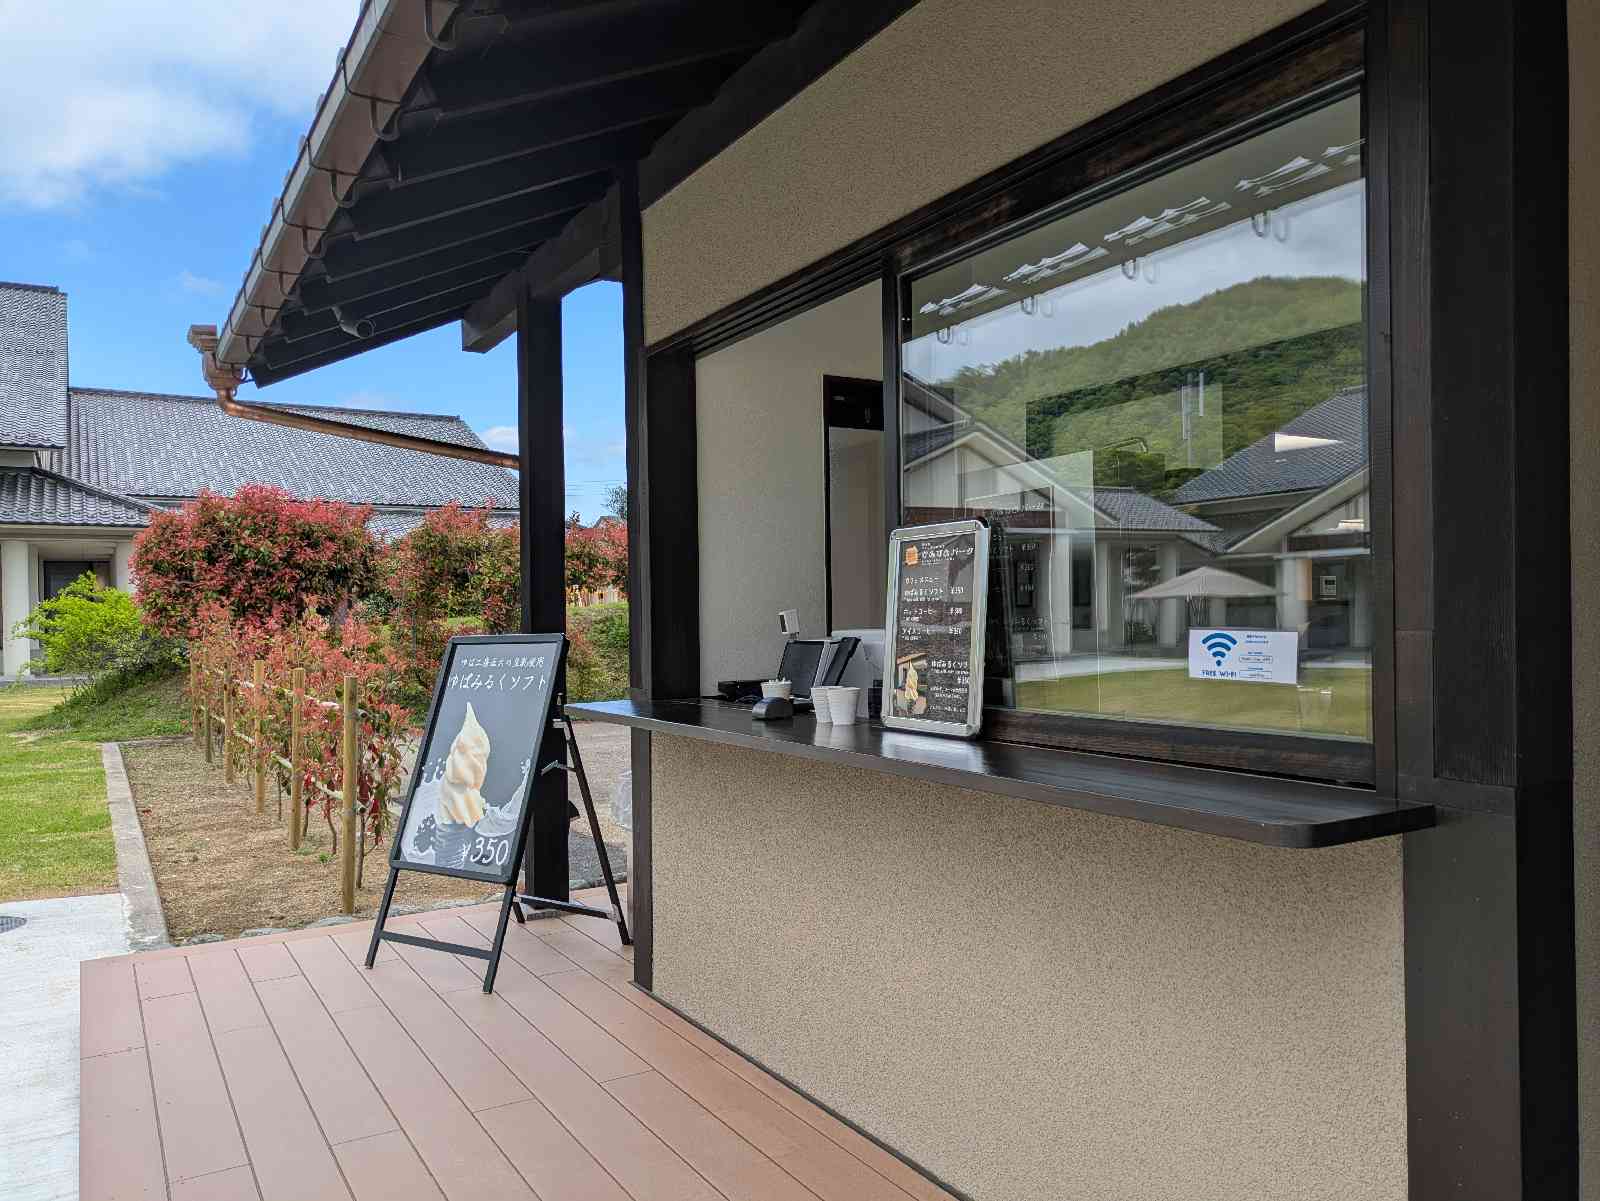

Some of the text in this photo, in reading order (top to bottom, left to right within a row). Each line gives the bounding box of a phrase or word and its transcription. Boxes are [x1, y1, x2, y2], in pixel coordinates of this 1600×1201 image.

[447, 672, 547, 691] ゆばみるくソフト
[461, 836, 509, 866] ¥350
